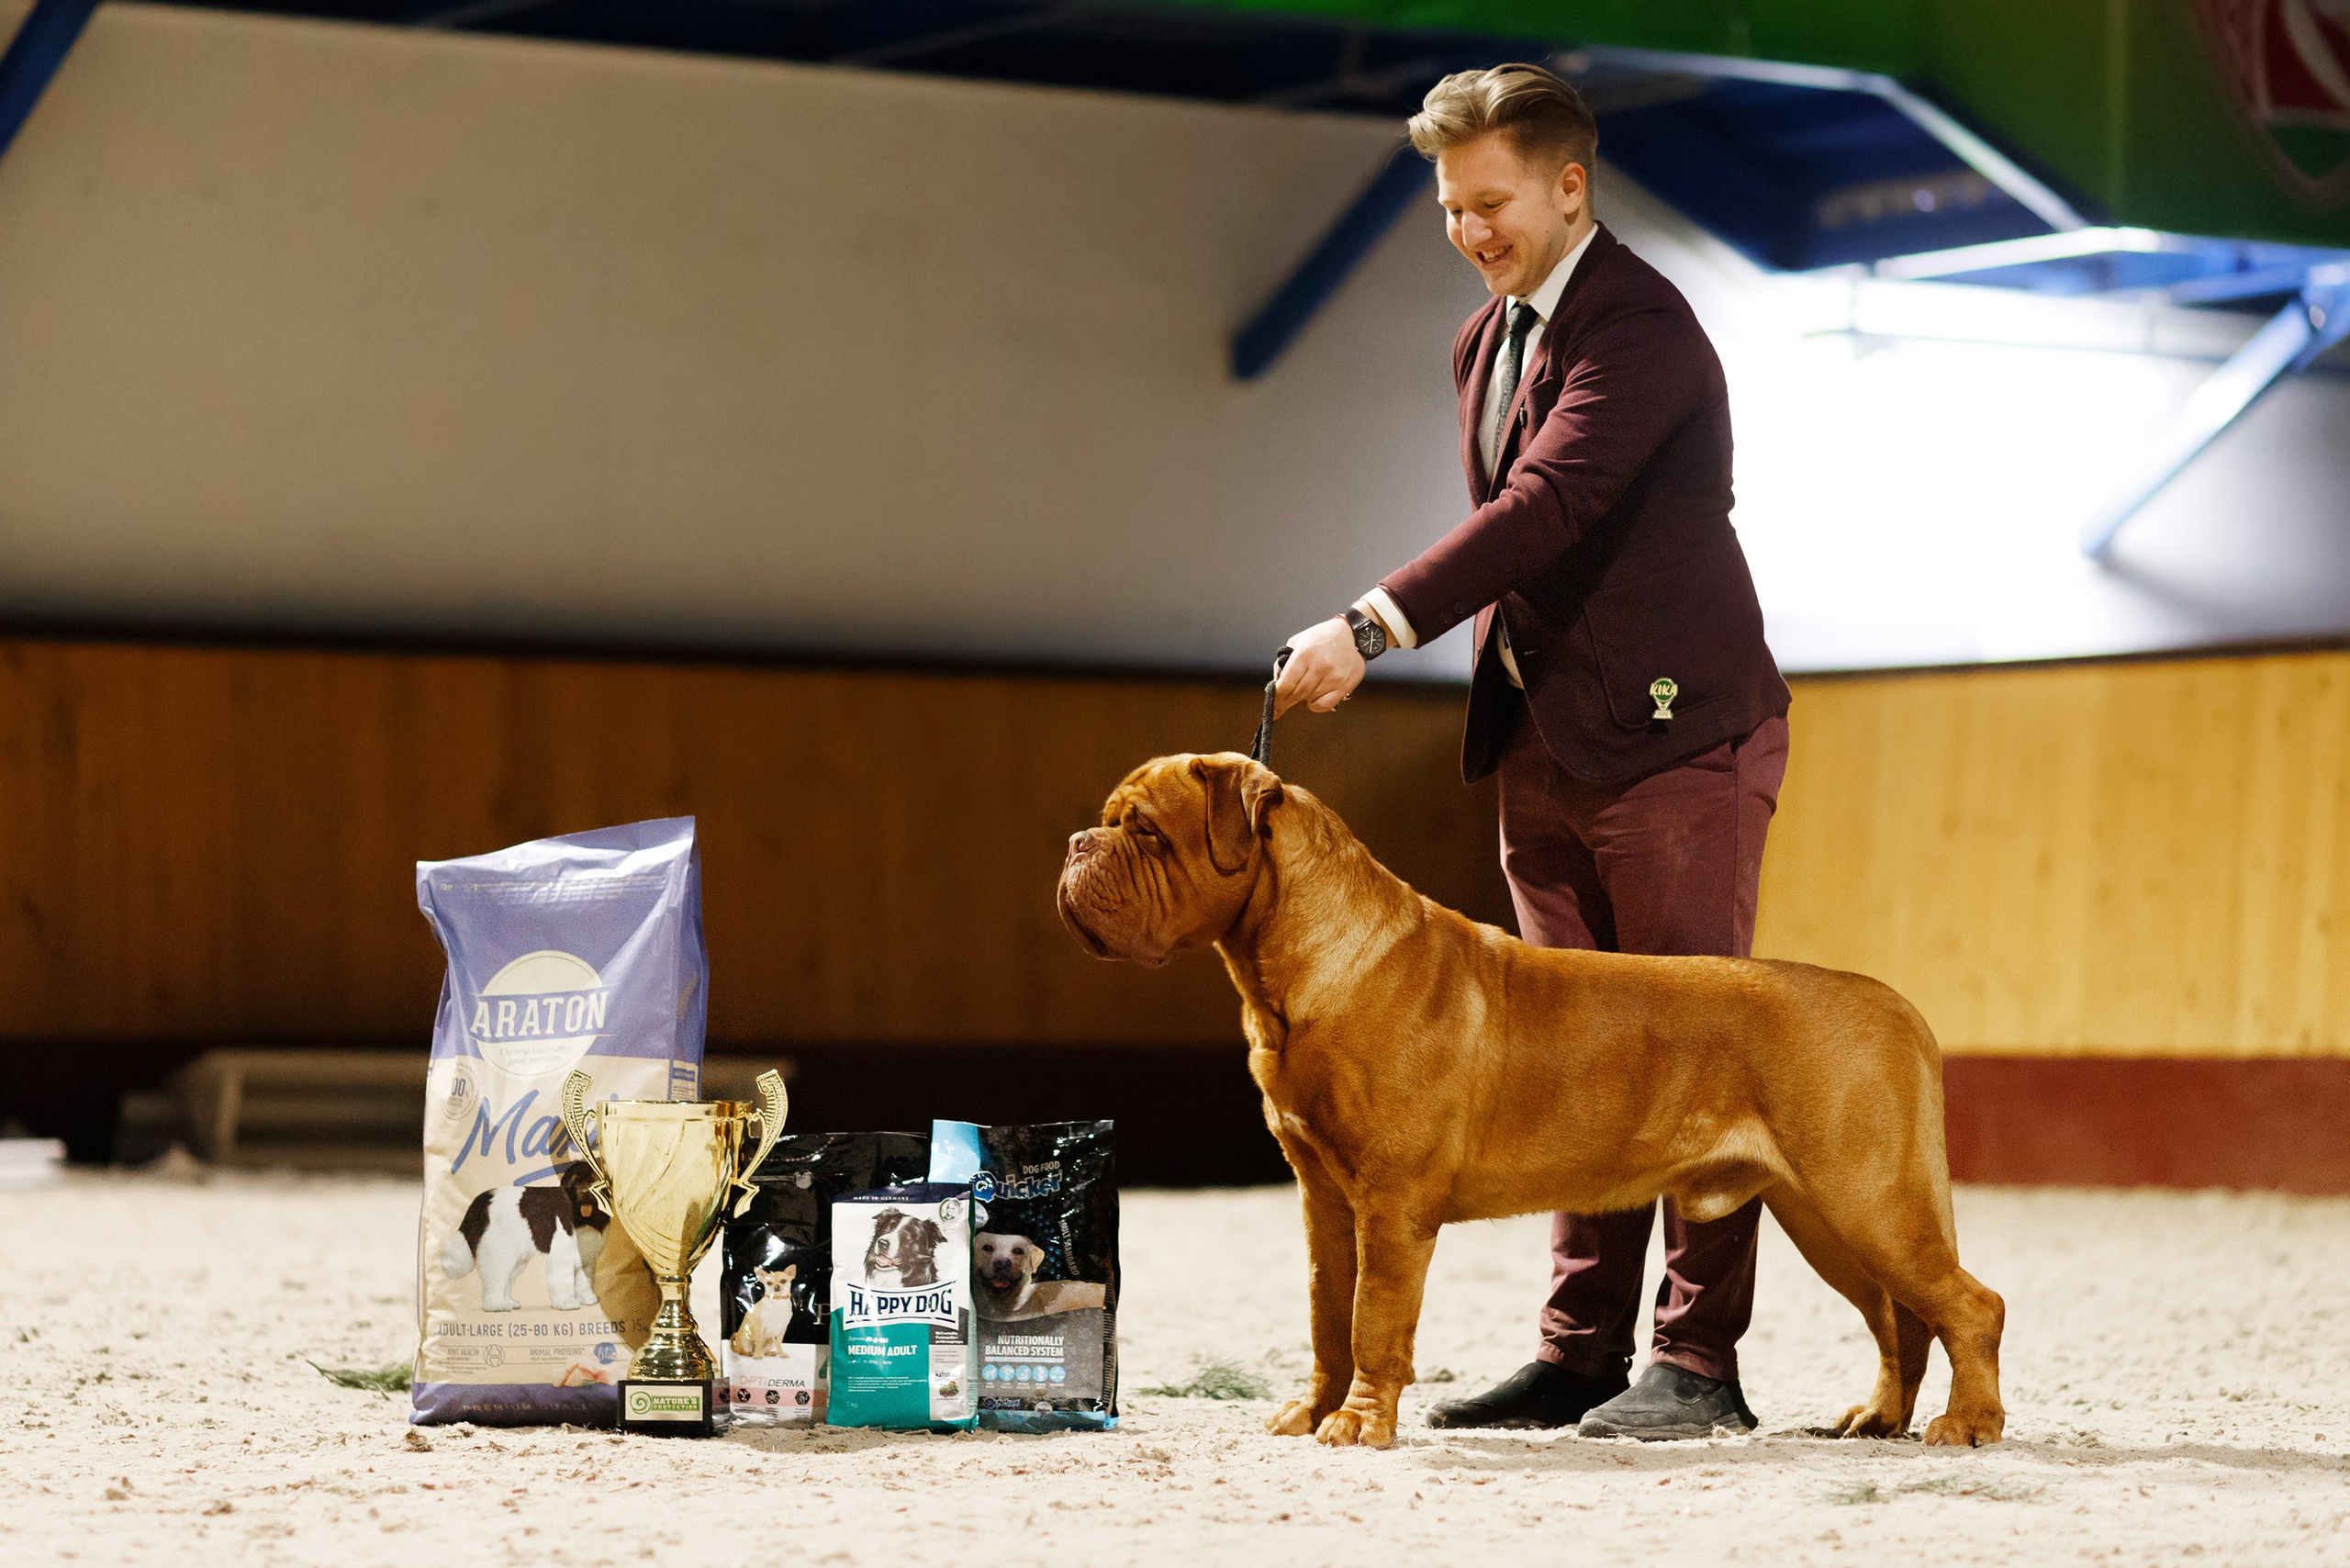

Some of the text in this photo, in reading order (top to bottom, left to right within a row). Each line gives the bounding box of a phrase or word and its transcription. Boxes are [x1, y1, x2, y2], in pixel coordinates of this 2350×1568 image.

[1650, 683, 1678, 696] KIKA
[470, 991, 609, 1037] ARATON
[1023, 1160, 1060, 1174] DOG FOOD
[968, 1170, 1063, 1204] Quicker
[915, 1288, 953, 1315] DOG
[554, 1322, 574, 1337] KG)
[579, 1320, 625, 1336] BREEDS
[998, 1335, 1064, 1346] NUTRITIONALLY
[848, 1345, 918, 1357] MEDIUM ADULT
[985, 1346, 1064, 1357] BALANCED SYSTEM
[653, 1396, 698, 1405] NATURE'S
[464, 1403, 532, 1412] PREMIUM
